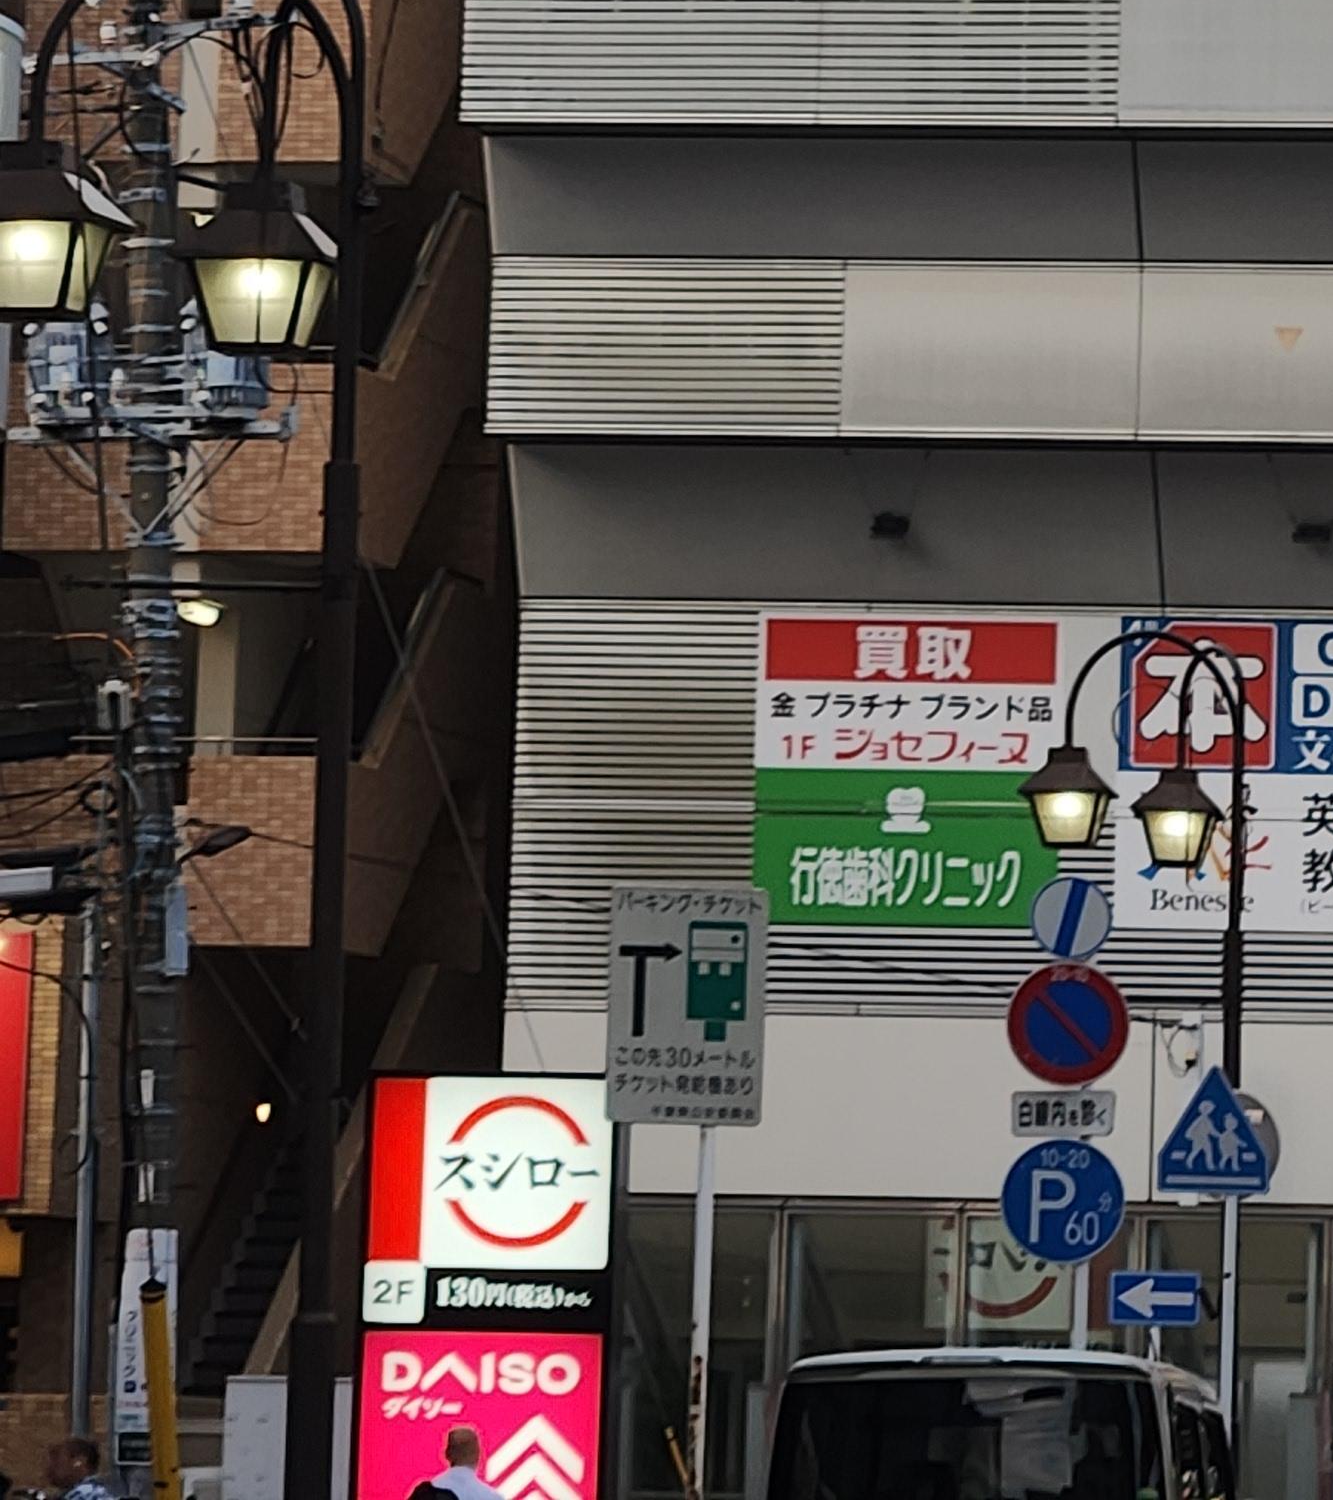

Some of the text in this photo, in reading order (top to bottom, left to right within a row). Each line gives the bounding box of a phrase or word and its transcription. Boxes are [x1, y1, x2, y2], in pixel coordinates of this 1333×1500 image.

[854, 625, 972, 680] 買取
[771, 692, 796, 718] 金
[1140, 639, 1267, 753] 本
[782, 728, 1030, 764] 1F ジョセフィーヌ
[790, 846, 1022, 908] 行徳歯科クリニック
[1150, 889, 1255, 913] Benese
[434, 1150, 601, 1192] スシロー
[1029, 1169, 1076, 1242] P
[373, 1279, 414, 1304] 2F
[382, 1351, 581, 1395] DAISO
[381, 1396, 463, 1421] ダイソー
